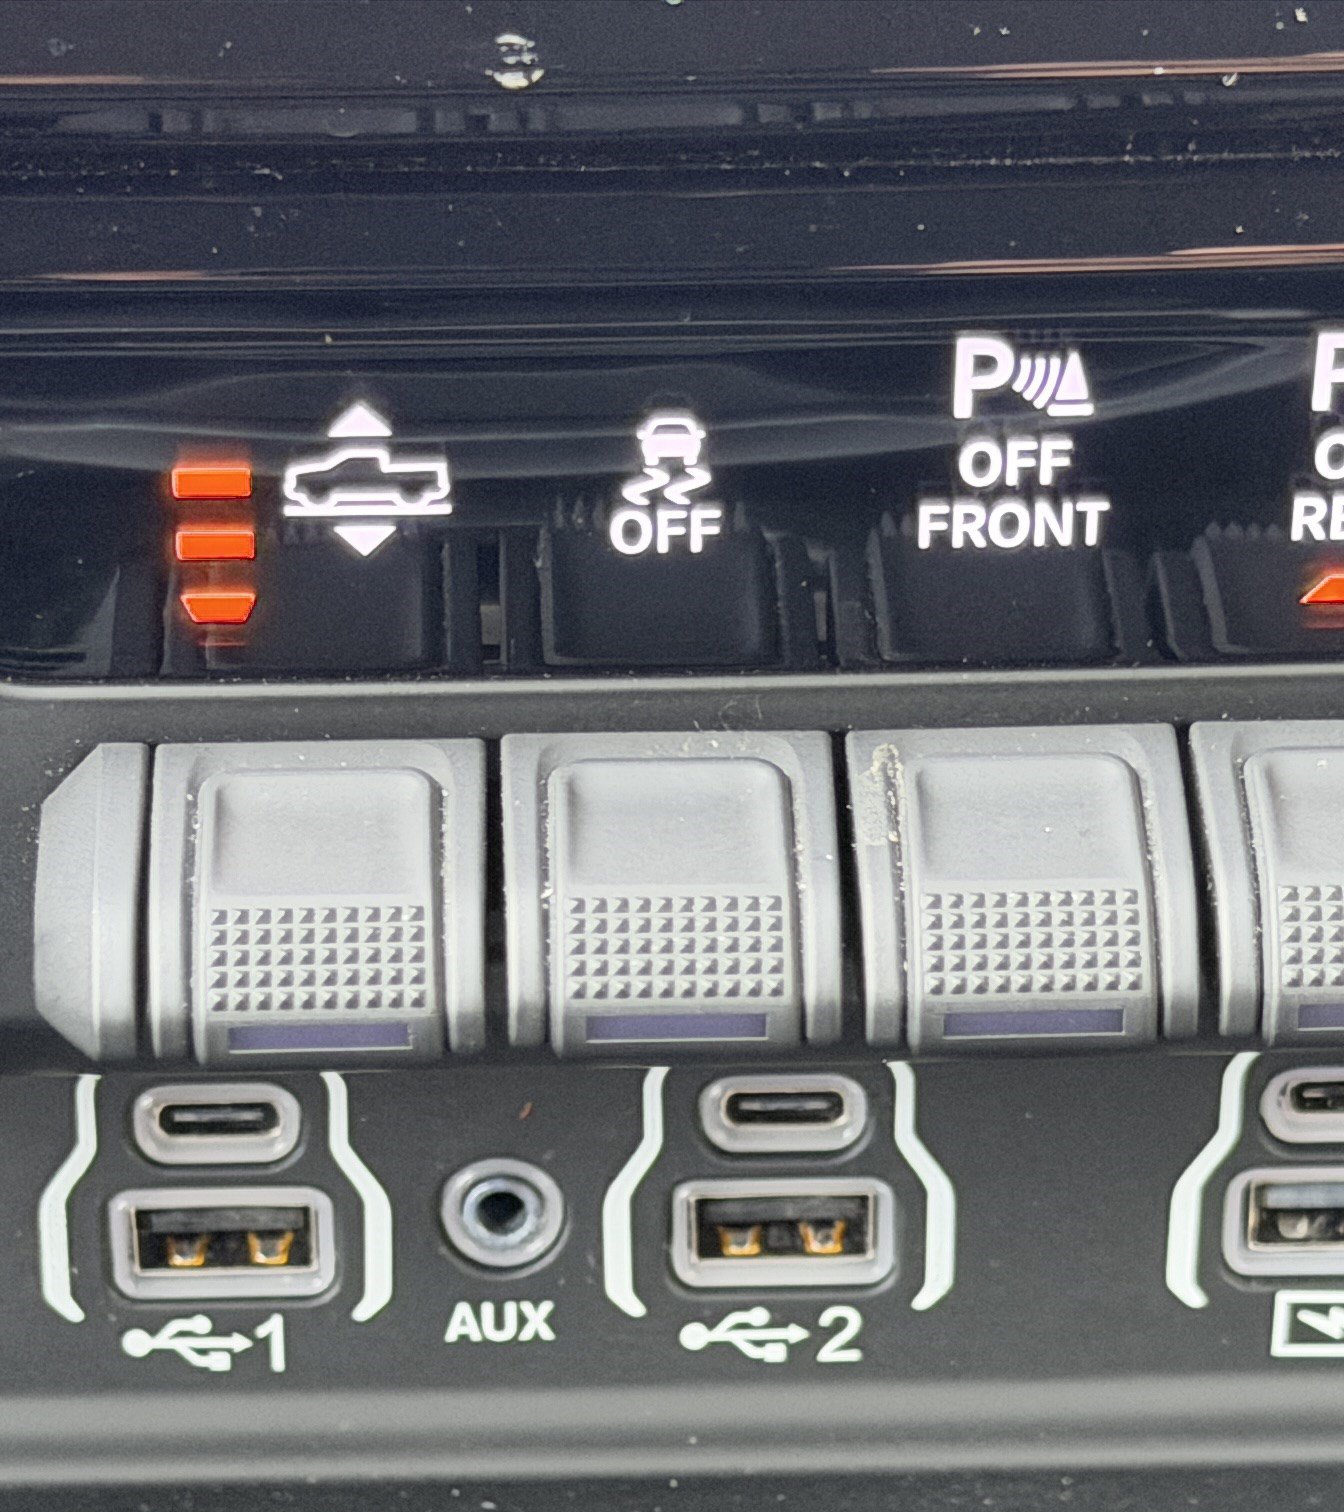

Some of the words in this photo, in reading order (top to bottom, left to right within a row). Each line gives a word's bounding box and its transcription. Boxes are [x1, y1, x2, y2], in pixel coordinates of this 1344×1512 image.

[958, 435, 1074, 488] OFF
[609, 504, 722, 555] OFF
[917, 497, 1111, 550] FRONT
[254, 1313, 286, 1373] 1
[444, 1300, 556, 1343] AUX
[816, 1305, 863, 1363] 2
